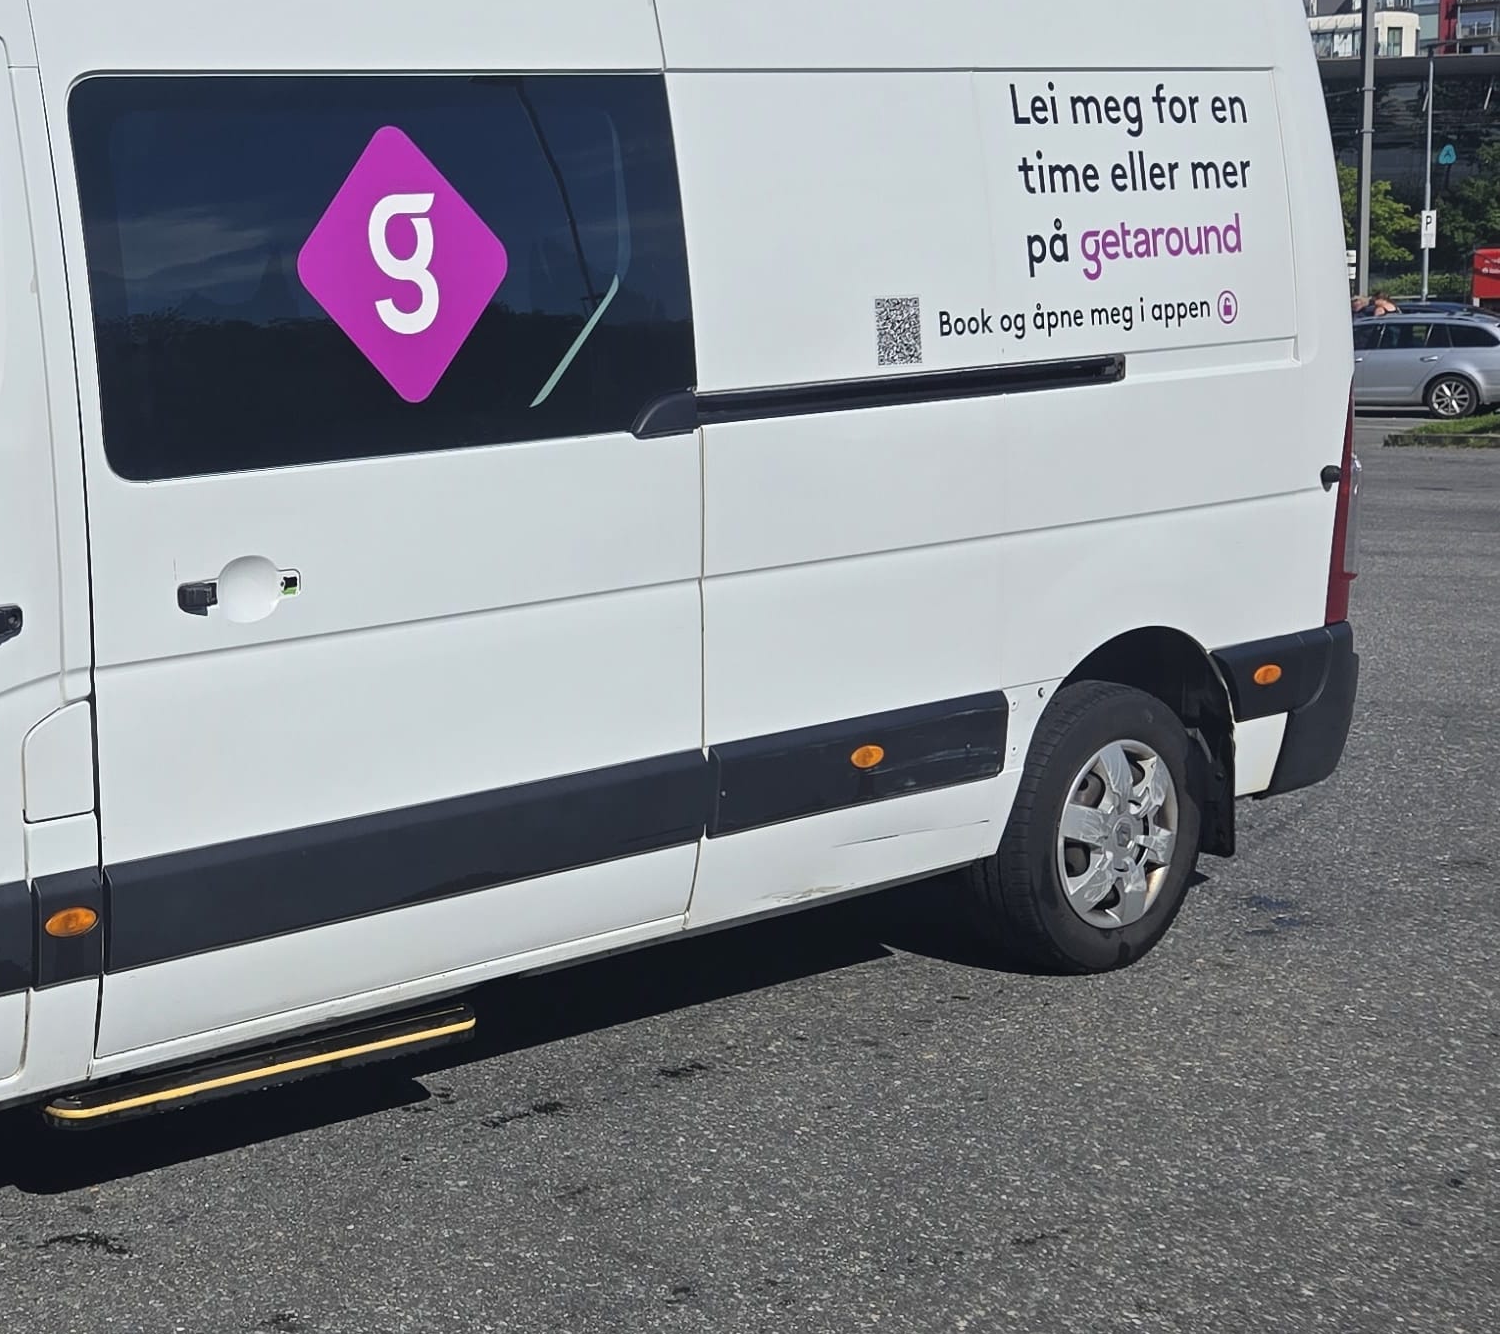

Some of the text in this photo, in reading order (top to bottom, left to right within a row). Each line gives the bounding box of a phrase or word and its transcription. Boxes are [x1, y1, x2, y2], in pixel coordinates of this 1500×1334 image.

[1009, 81, 1248, 138] Lei meg for en
[1017, 149, 1251, 195] time eller mer
[1026, 212, 1242, 281] på getaround
[1424, 215, 1433, 232] P
[368, 192, 440, 335] g
[938, 296, 1212, 339] Book og åpne meg i appen
